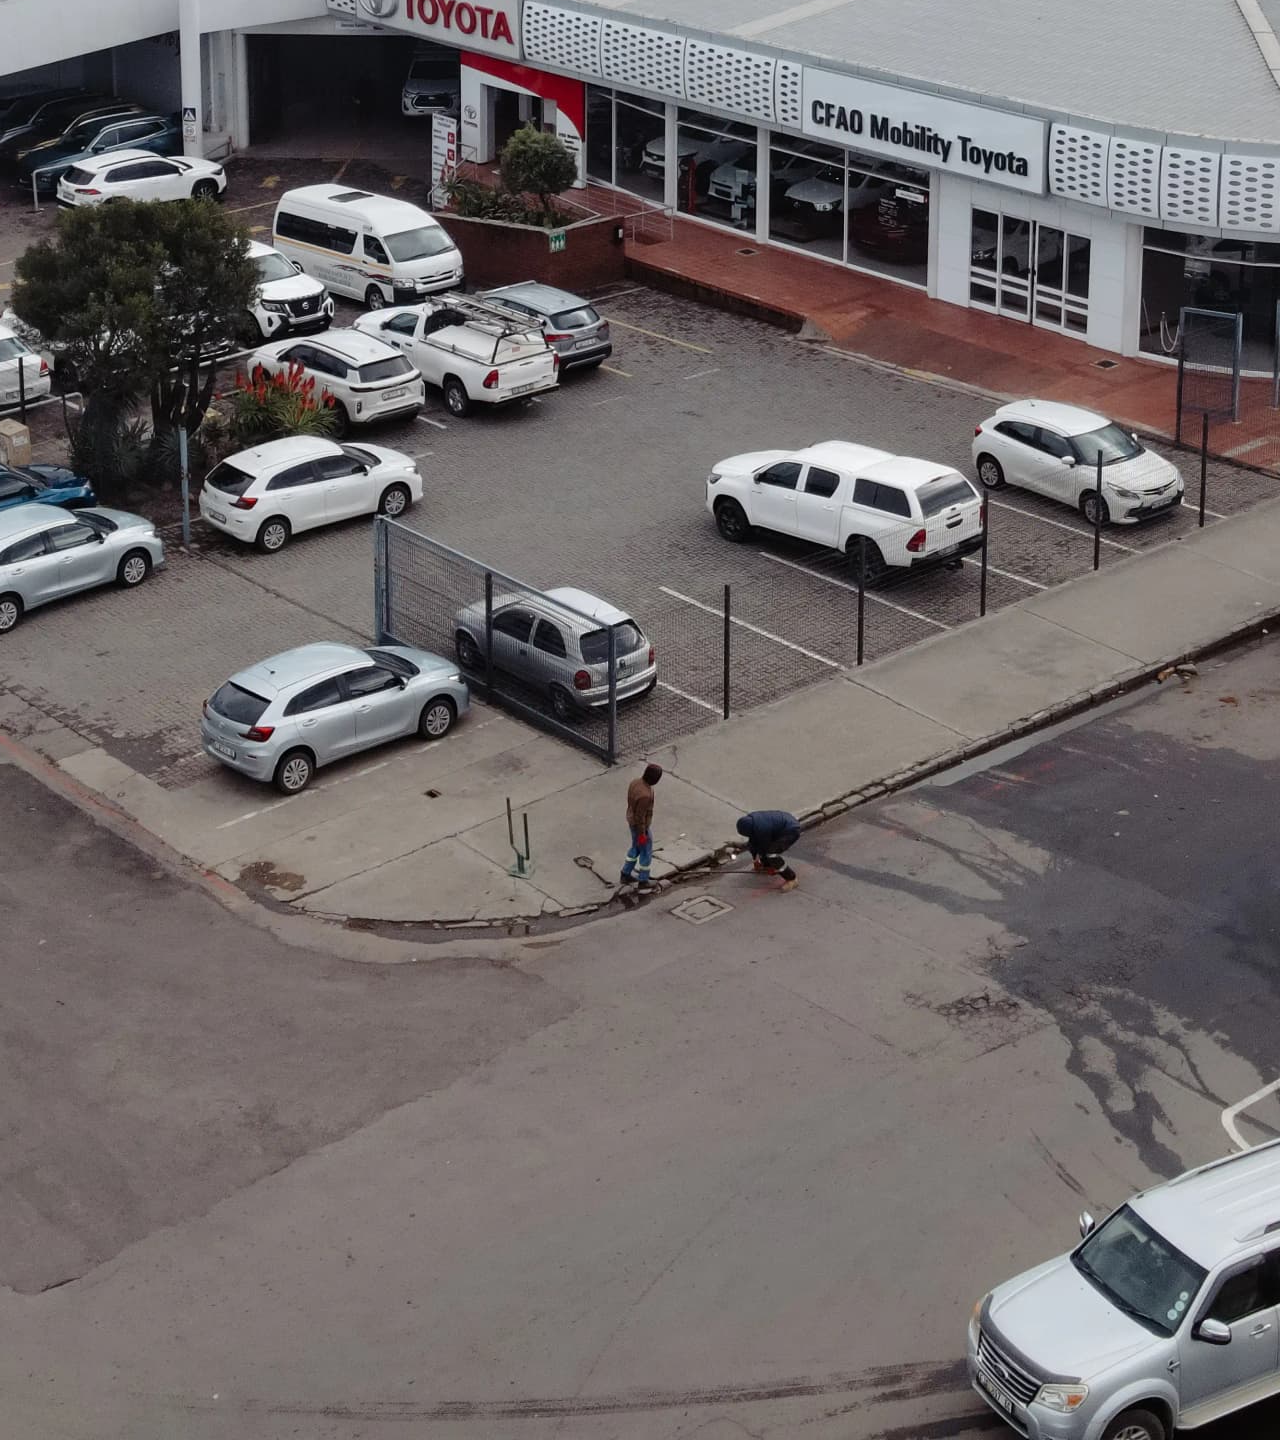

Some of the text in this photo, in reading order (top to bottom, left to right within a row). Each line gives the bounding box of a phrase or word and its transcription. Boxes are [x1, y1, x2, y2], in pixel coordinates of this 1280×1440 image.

[811, 99, 1029, 177] CFAO Mobility Toyota
